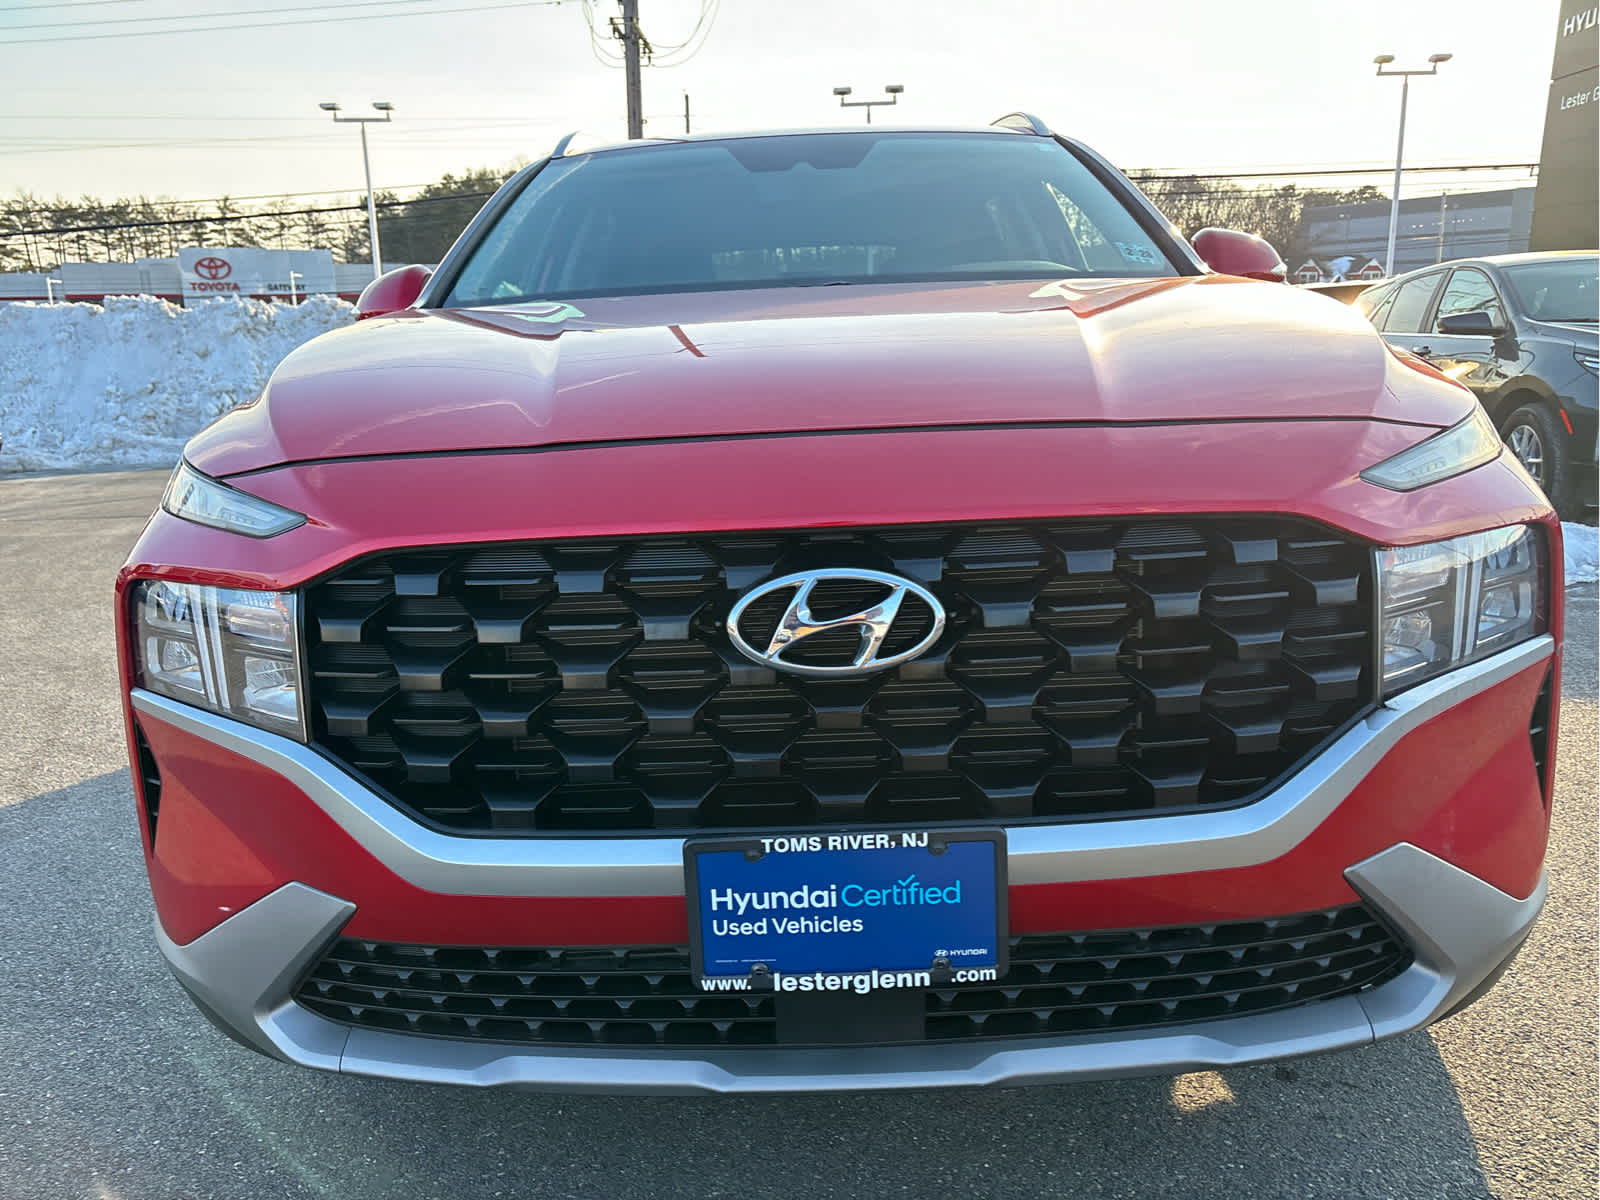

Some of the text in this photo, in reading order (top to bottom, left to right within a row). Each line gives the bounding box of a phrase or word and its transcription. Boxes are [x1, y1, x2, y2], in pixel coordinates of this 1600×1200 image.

[1563, 7, 1600, 37] HYU
[1560, 91, 1591, 110] Lester
[190, 282, 240, 291] TOYOTA
[761, 832, 928, 853] TOMS RIVER, NJ
[710, 874, 960, 915] Hyundai Certified
[712, 915, 864, 936] Used Vehicles
[950, 948, 988, 956] HYUNDAI
[701, 968, 996, 994] www. lesterglenn .com
